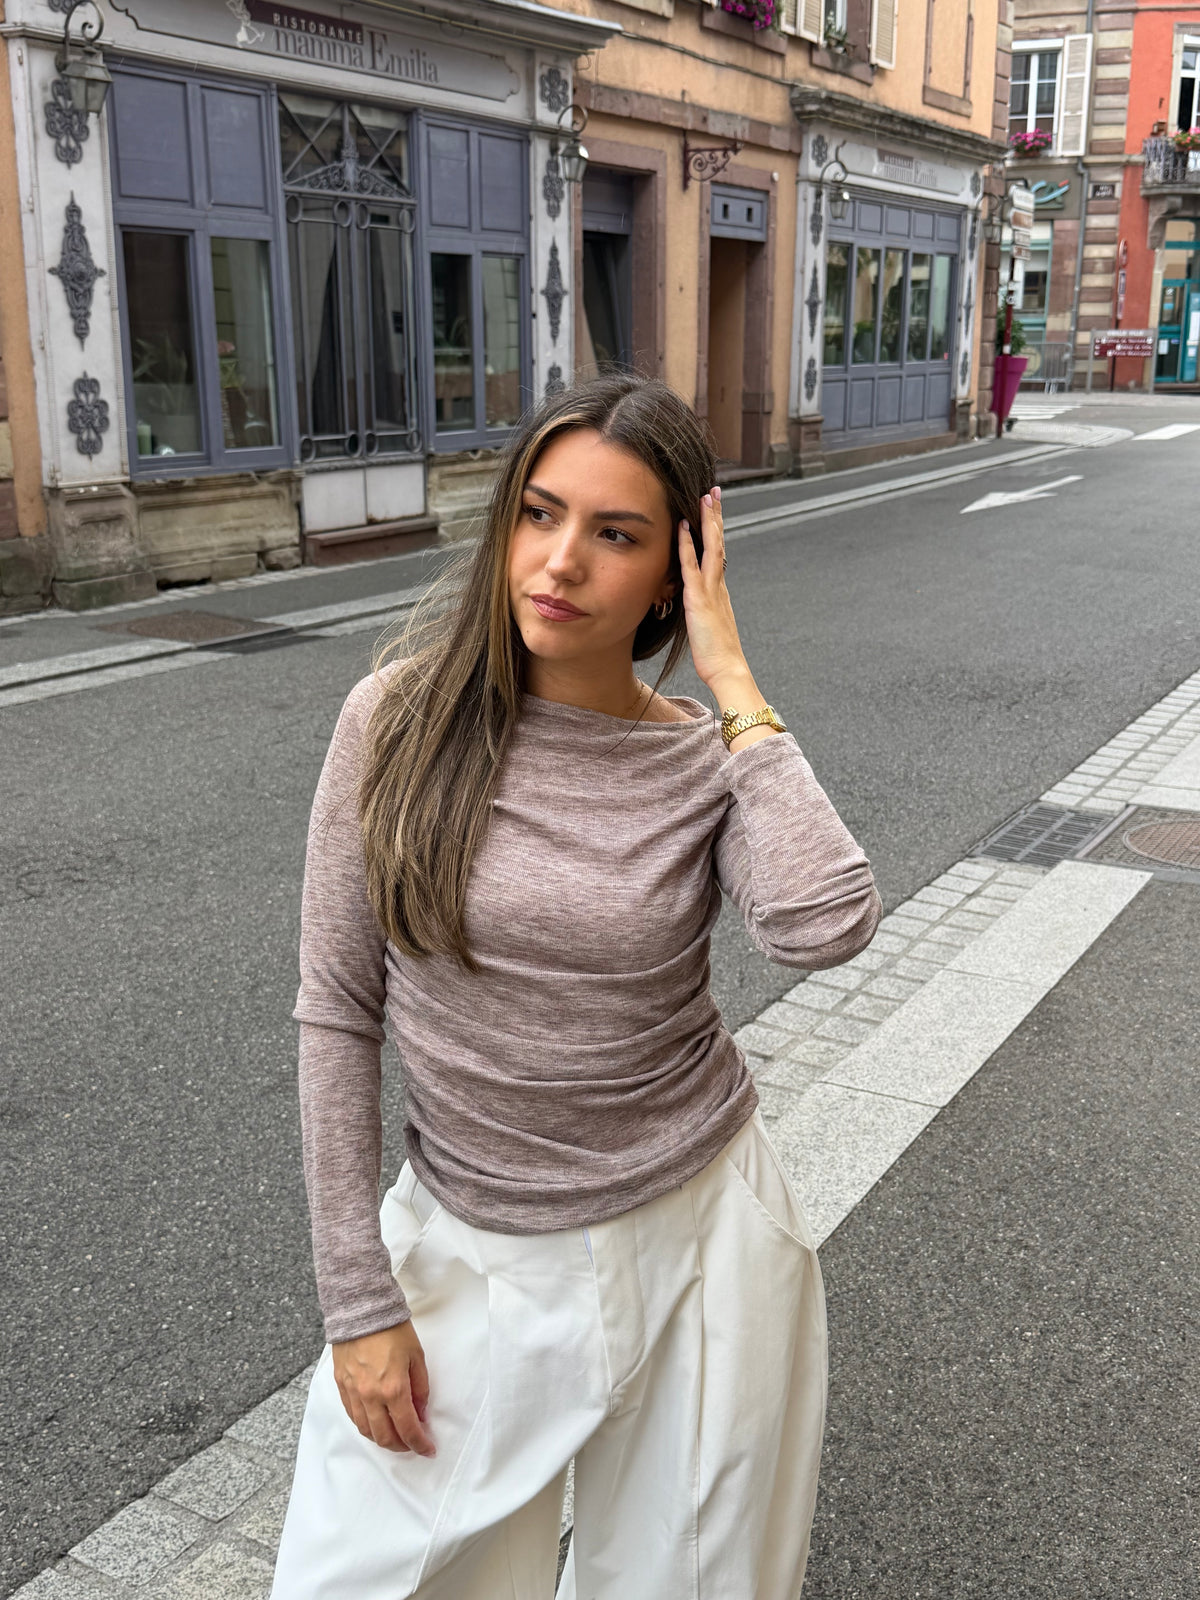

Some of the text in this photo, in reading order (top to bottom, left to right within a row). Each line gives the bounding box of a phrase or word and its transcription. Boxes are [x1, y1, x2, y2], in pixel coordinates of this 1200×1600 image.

[273, 12, 363, 44] RISTORANTE
[274, 29, 439, 84] mamma Emilia
